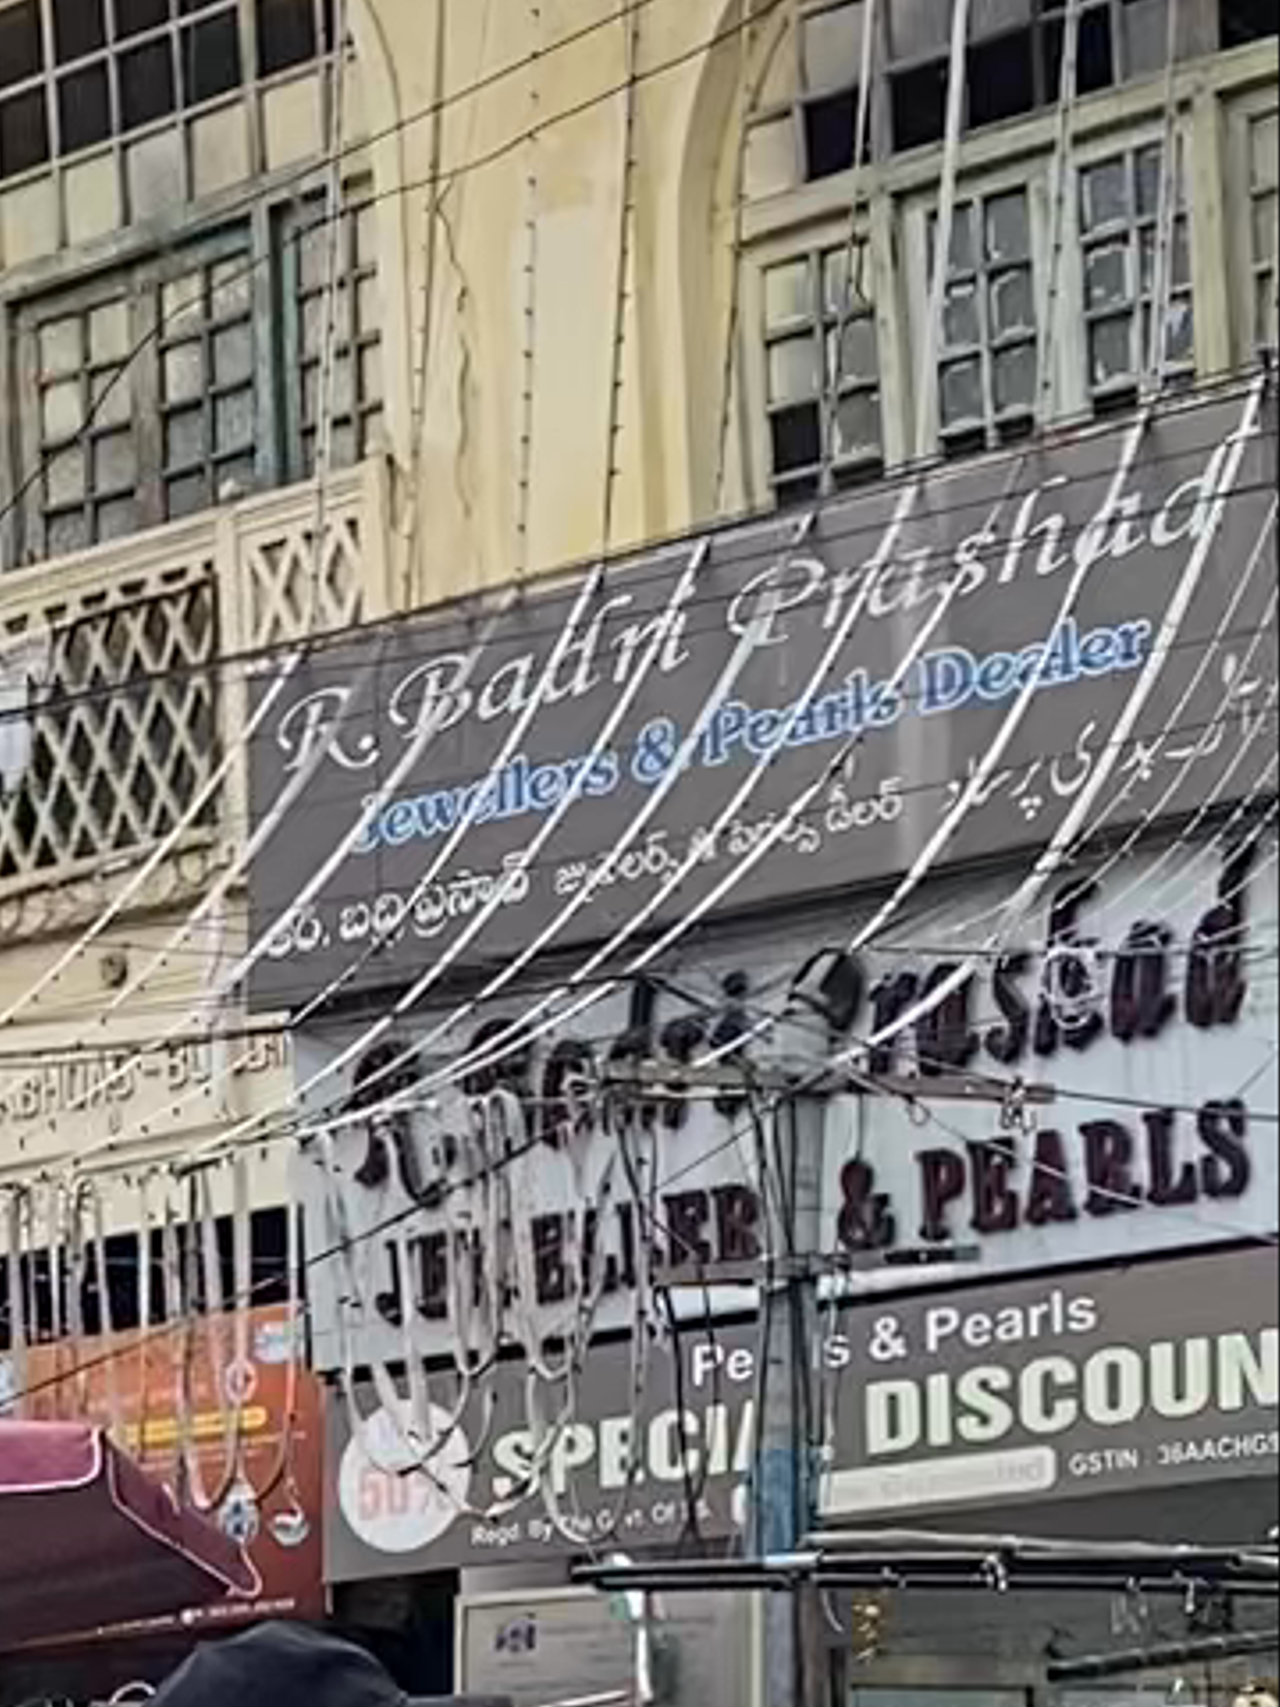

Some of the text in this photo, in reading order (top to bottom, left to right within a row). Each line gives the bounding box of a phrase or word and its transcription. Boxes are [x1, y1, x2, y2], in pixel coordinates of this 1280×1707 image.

[390, 593, 688, 743] Badri
[632, 717, 688, 784] &
[703, 677, 904, 770] Pearls
[916, 617, 1152, 715] Dealer
[870, 828, 1252, 1078] rashad
[838, 1157, 895, 1250] &
[917, 1098, 1254, 1241] PEARLS
[868, 1315, 908, 1362] &
[926, 1289, 1098, 1353] Pearls
[491, 1400, 756, 1497] SPECI
[1068, 1447, 1139, 1476] GSTIN
